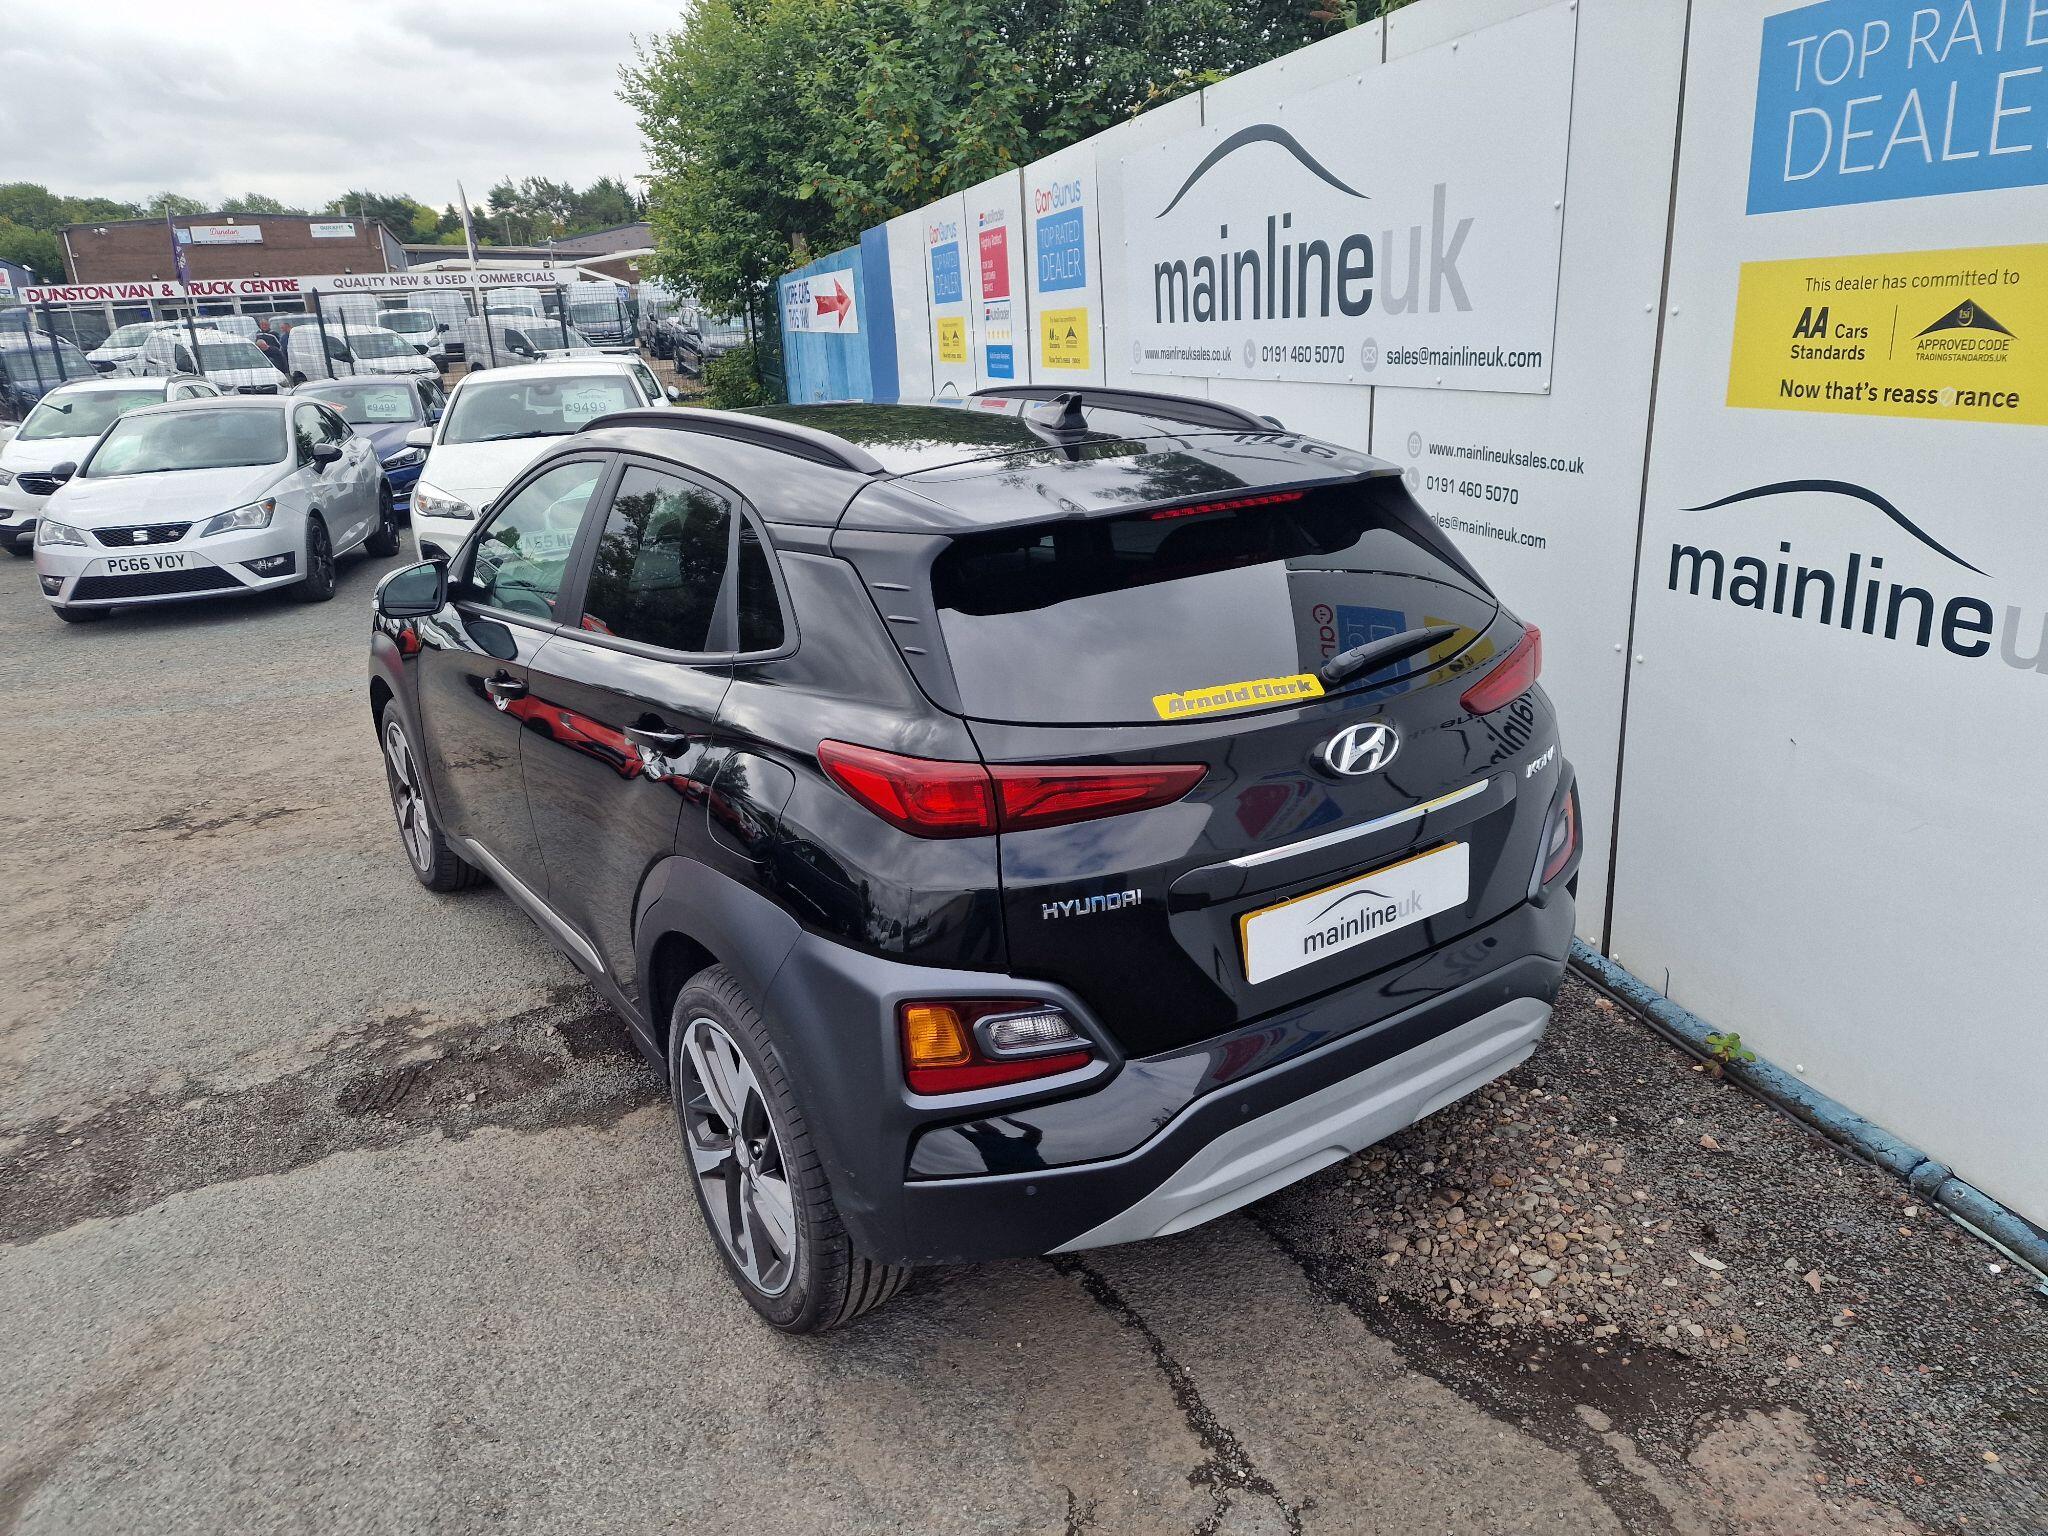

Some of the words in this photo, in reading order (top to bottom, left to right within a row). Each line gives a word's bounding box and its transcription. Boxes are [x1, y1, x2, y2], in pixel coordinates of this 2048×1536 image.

[1787, 20, 1890, 92] TOP
[1783, 66, 2048, 182] DEALE
[1035, 180, 1082, 214] CarGurus
[1040, 226, 1054, 249] TOP
[1055, 219, 1080, 246] RATED
[1042, 248, 1082, 282] DEALER
[1154, 183, 1475, 324] mainlineuk
[26, 286, 113, 303] DUNSTON
[115, 283, 154, 299] VAN
[161, 283, 174, 297] &
[240, 278, 299, 294] CENTRE
[333, 276, 385, 289] QUALITY
[389, 275, 420, 287] NEW
[423, 275, 432, 286] &
[435, 274, 467, 285] USED
[1805, 277, 1831, 292] This
[1835, 274, 1878, 291] dealer
[1882, 274, 1907, 289] has
[1911, 270, 1998, 288] committed
[2003, 268, 2020, 285] to
[1792, 306, 1829, 339] AA
[1834, 323, 1868, 339] Cars
[1144, 345, 1232, 362] www.mainlineuksales.co.uk
[1262, 345, 1287, 363] 0191
[1290, 345, 1312, 363] 460
[1314, 345, 1345, 364] 5070
[1386, 345, 1542, 368] sales@mainlineuk.com
[1790, 345, 1866, 361] Standards
[1917, 339, 1976, 351] APPROVED
[1978, 339, 2010, 351] CODE
[1779, 379, 1821, 398] Now
[1825, 381, 1878, 402] that's
[1883, 387, 2020, 409] reassrance
[1428, 443, 1585, 475] www.mainlineuksales.co.uk
[1426, 475, 1455, 494] 0191
[1458, 480, 1482, 499] 460
[1485, 485, 1519, 505] 5070
[1430, 512, 1547, 550] ales@mainlineuk.com
[107, 557, 151, 573] PG66
[154, 554, 185, 569] VOY
[1168, 685, 1251, 714] Arnold
[1251, 679, 1314, 698] Clark
[1042, 888, 1142, 920] HYUNDAI
[1303, 889, 1425, 956] mainlineuk
